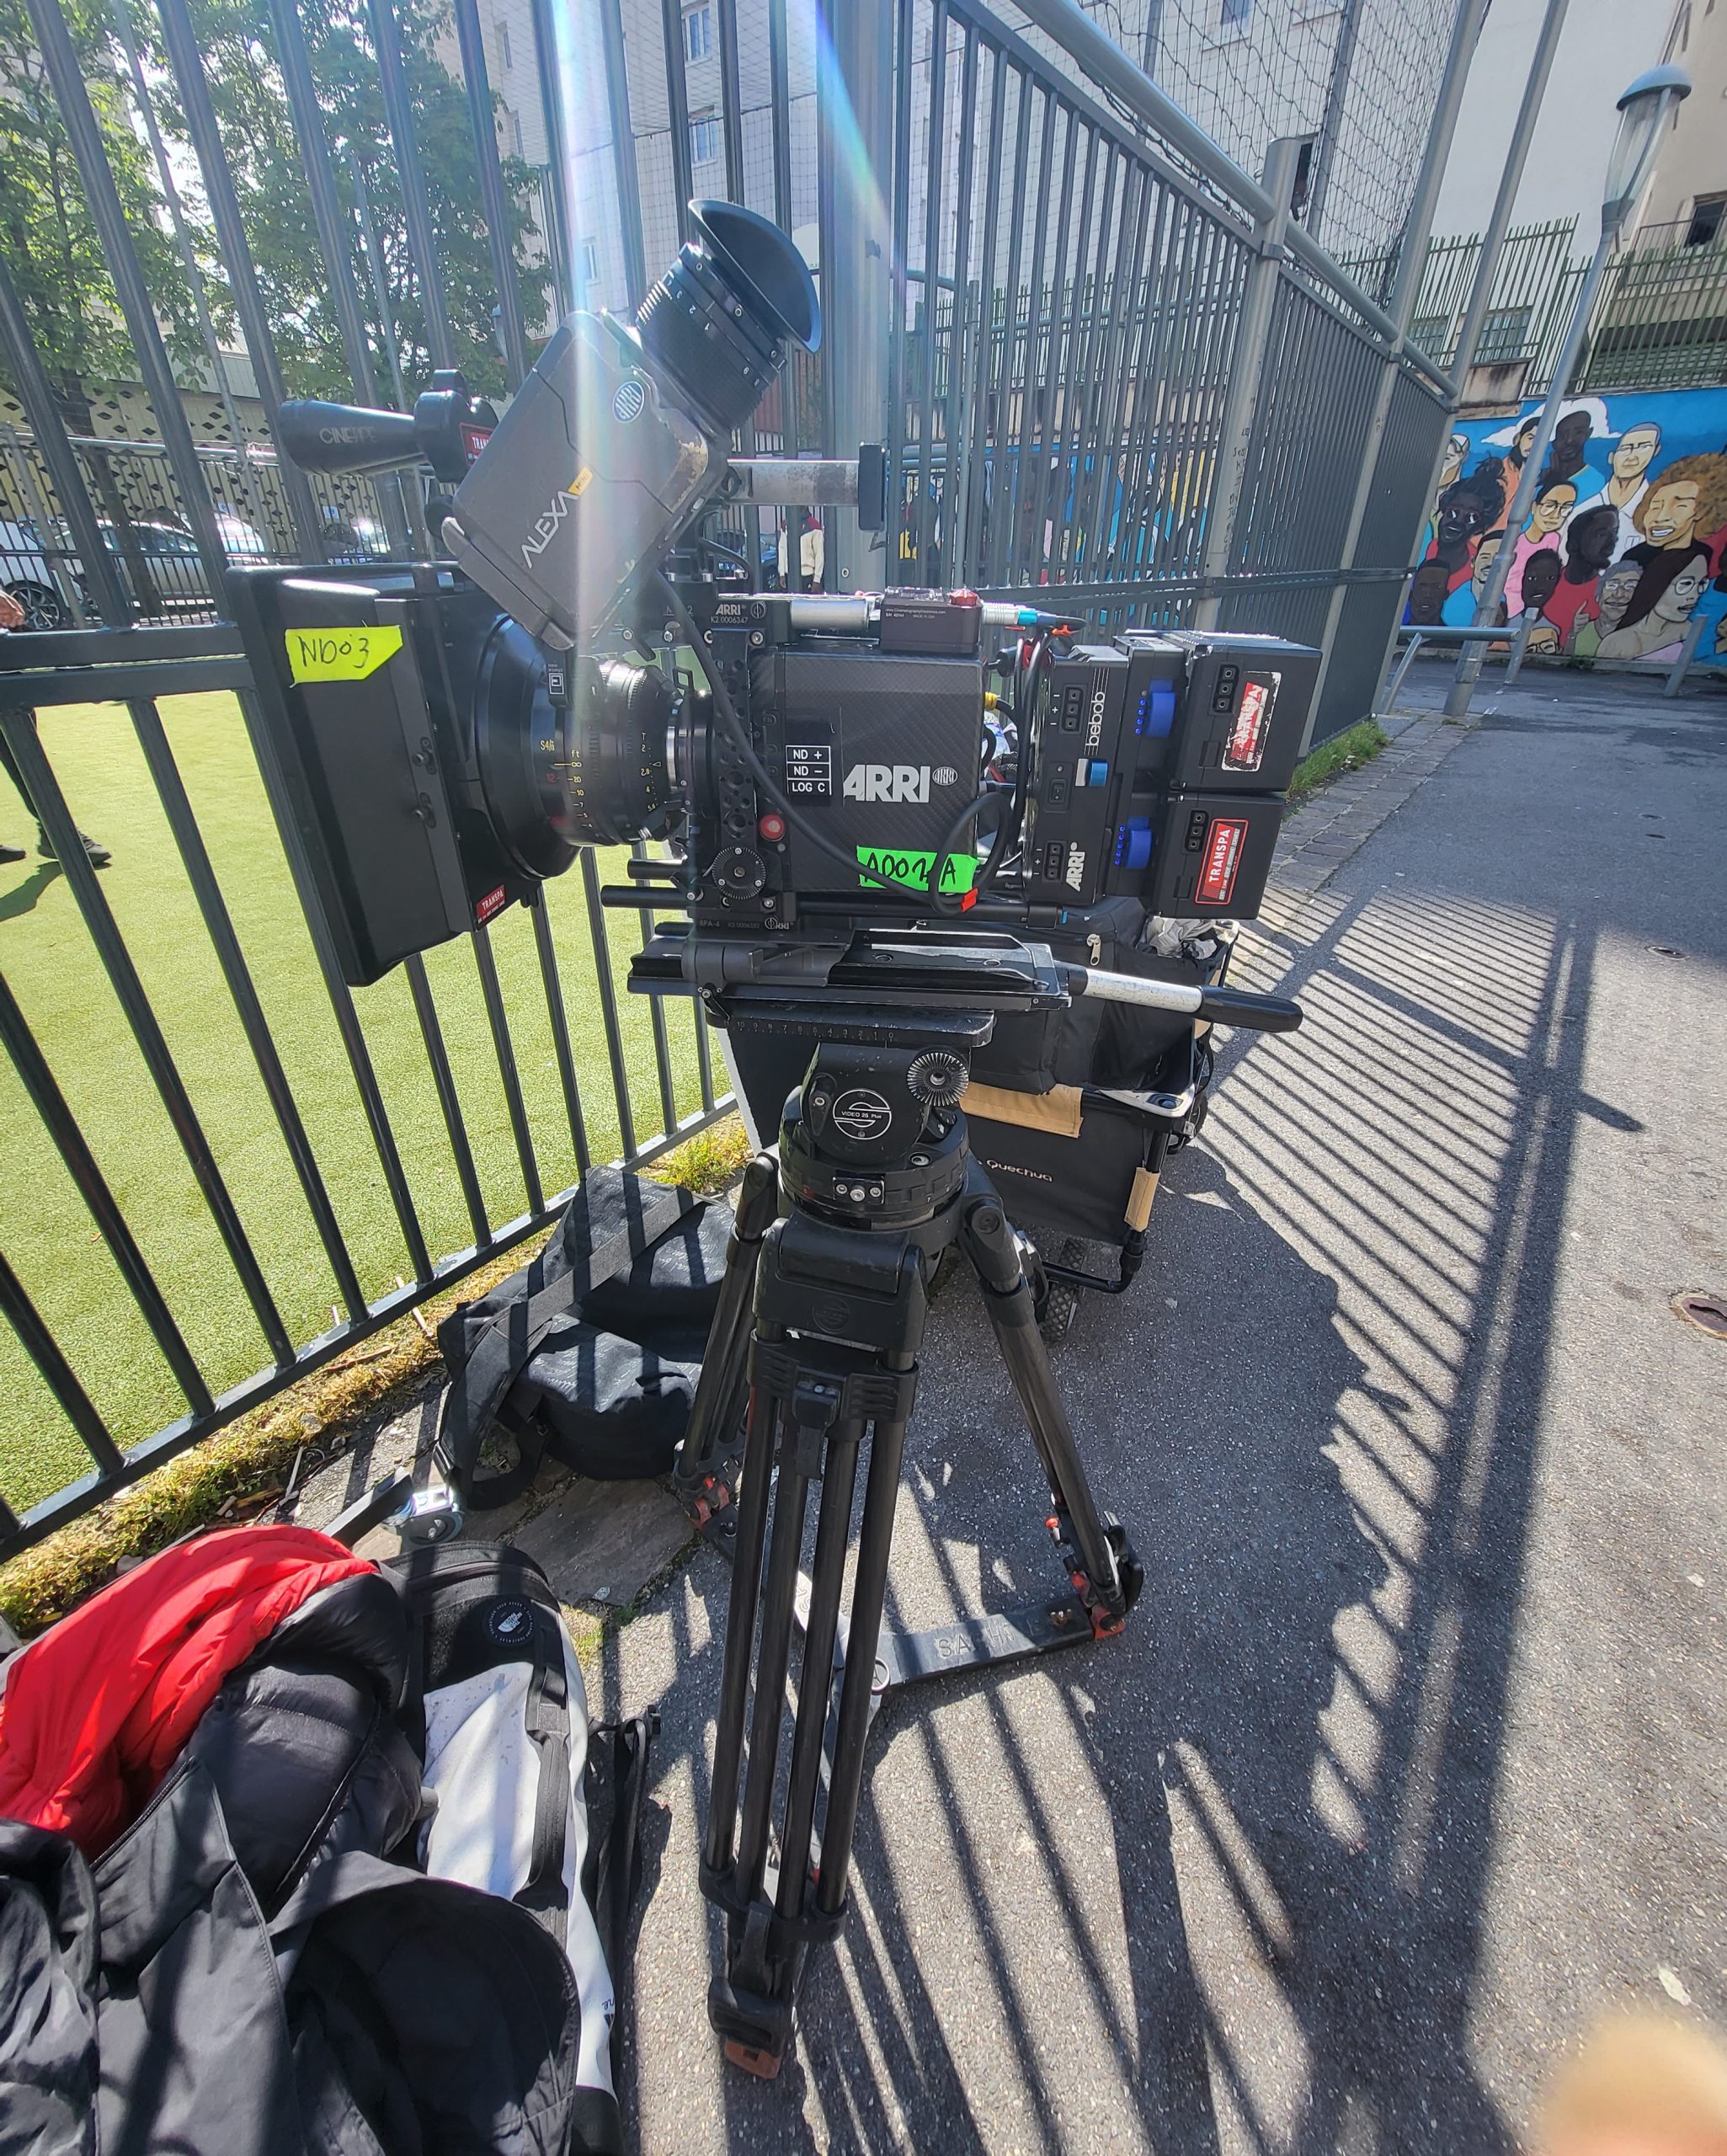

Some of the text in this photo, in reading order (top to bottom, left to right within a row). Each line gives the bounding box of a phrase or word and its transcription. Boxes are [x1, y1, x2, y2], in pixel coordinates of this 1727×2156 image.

[615, 384, 642, 420] ARRI
[521, 490, 580, 569] ALEXA
[716, 603, 742, 616] ARRI
[1085, 691, 1106, 746] bebob
[571, 750, 580, 758] ft
[793, 749, 808, 760] ND
[793, 765, 809, 776] ND
[934, 767, 957, 785] ARRI
[792, 782, 825, 792] LOG C
[843, 764, 930, 803] ARRI
[1208, 828, 1231, 883] TRANSPA
[1065, 851, 1086, 893] ARRI
[481, 889, 504, 910] TRANSPA
[841, 1110, 861, 1118] VIDEO
[986, 1159, 1053, 1183] Quechua
